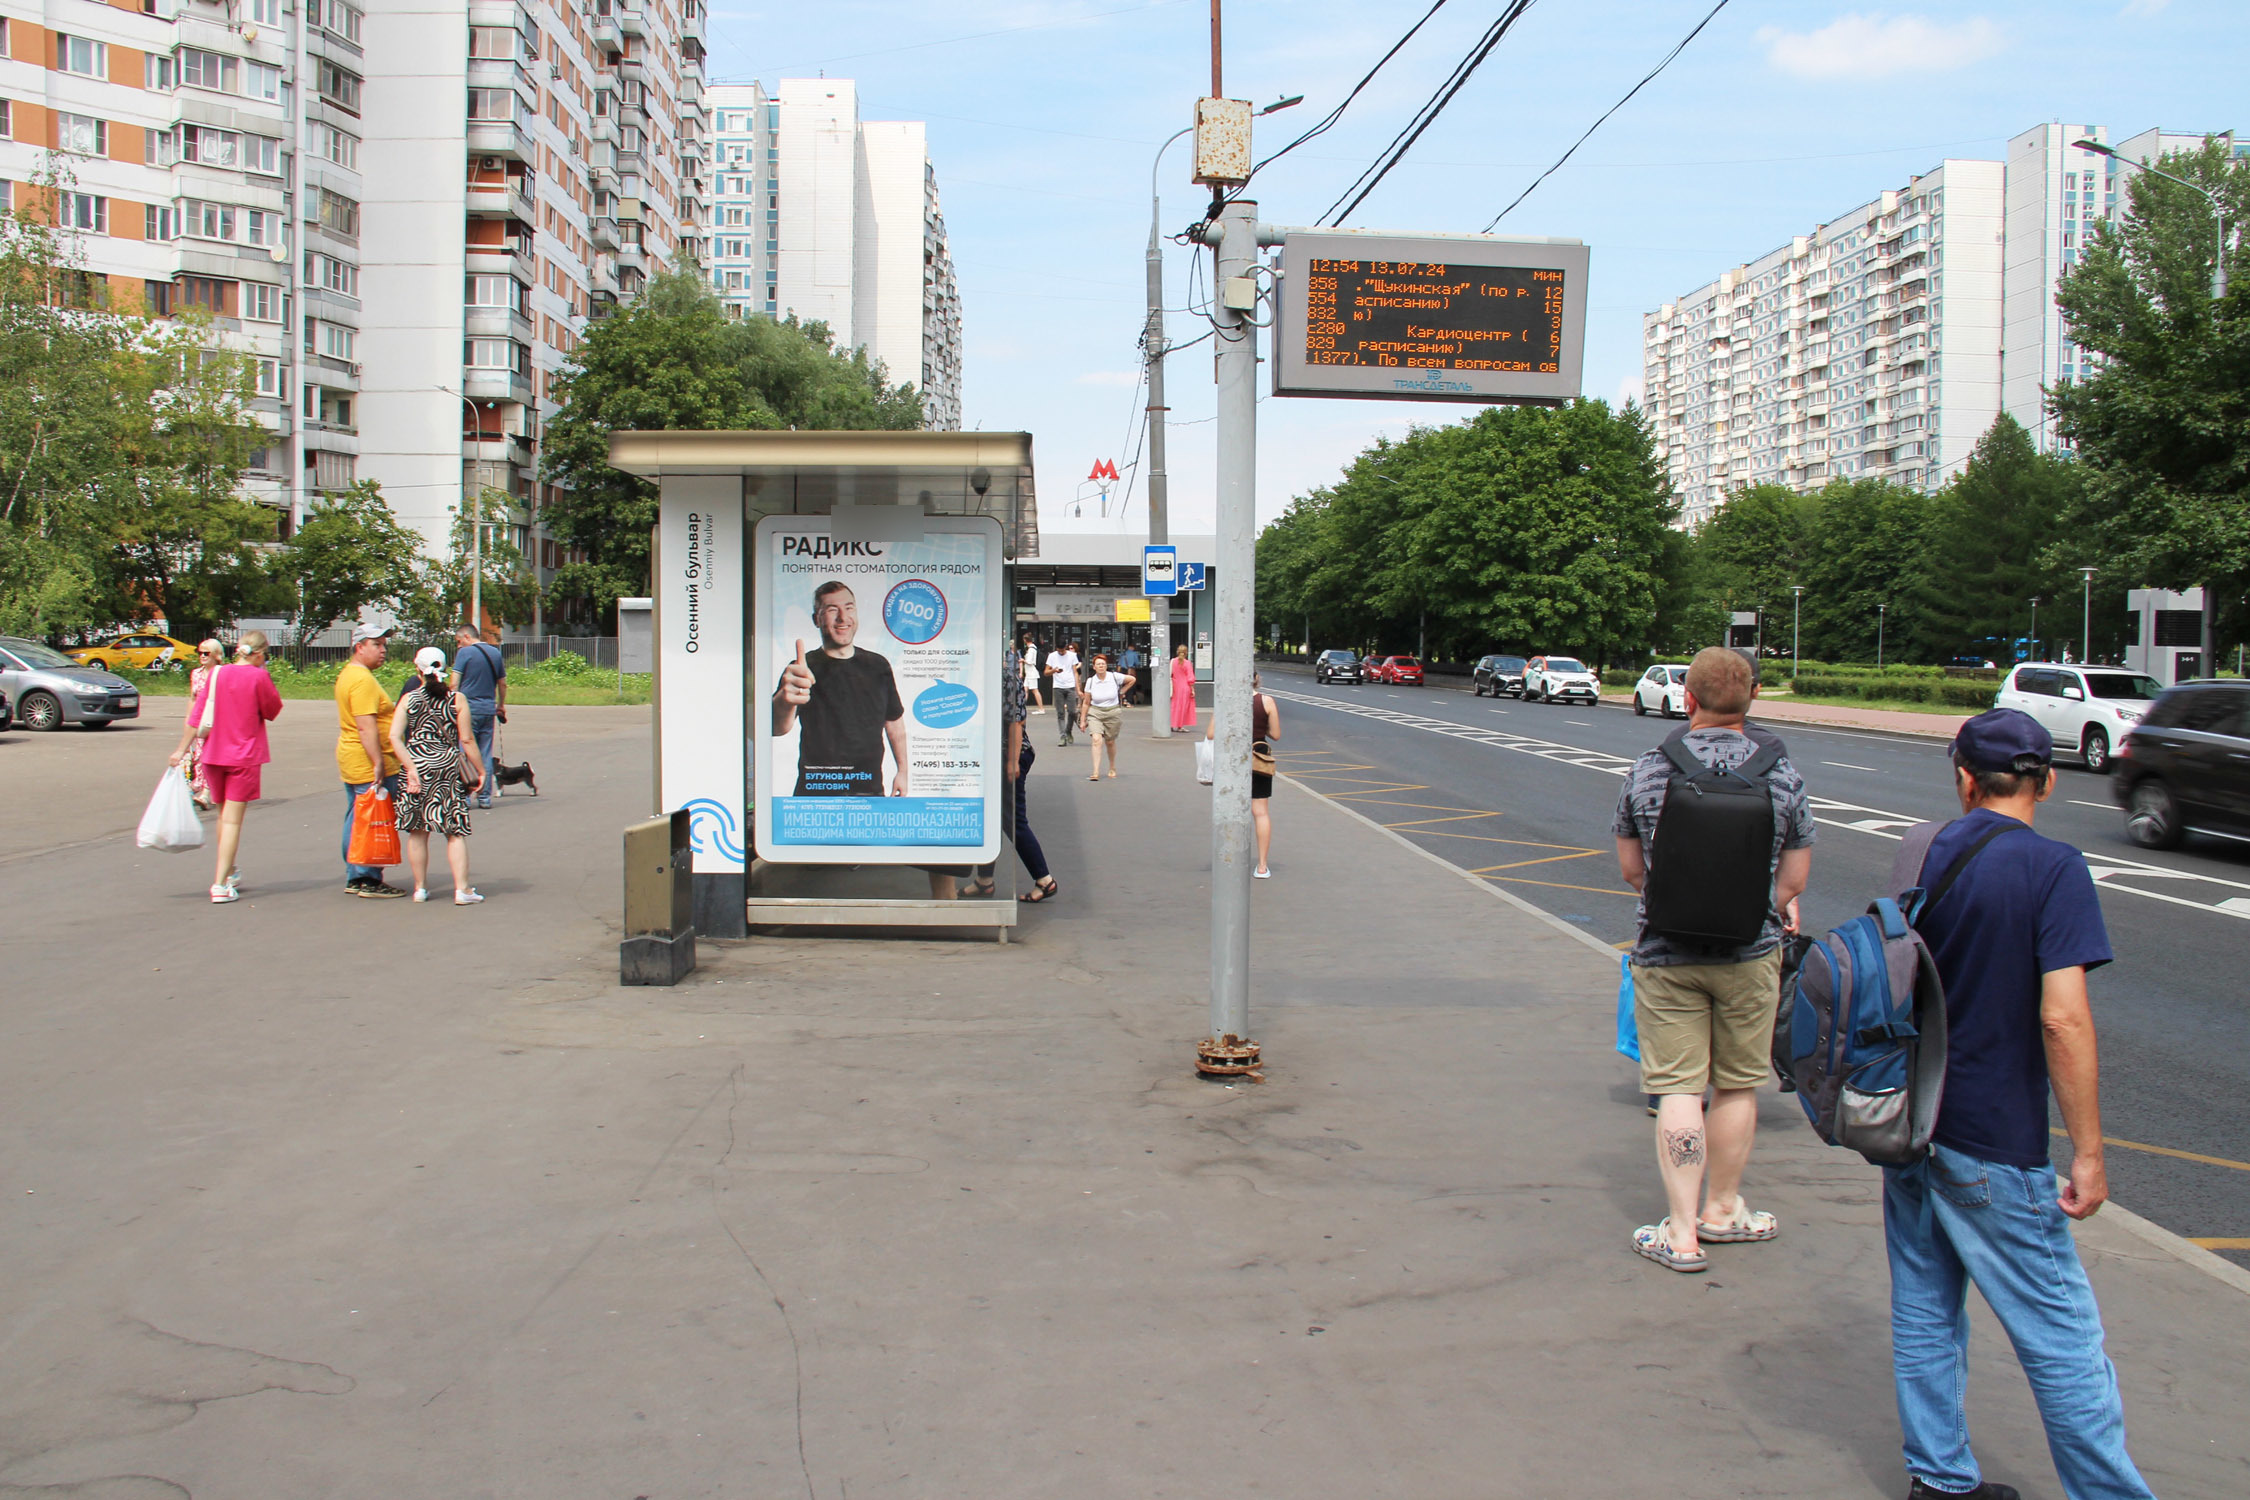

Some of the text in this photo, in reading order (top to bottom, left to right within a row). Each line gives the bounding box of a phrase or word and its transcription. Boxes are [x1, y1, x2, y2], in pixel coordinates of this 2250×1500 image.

[1312, 259, 1446, 276] 12:54 13.07.24
[1308, 276, 1338, 290] 358
[1545, 286, 1563, 300] 12
[1308, 292, 1563, 314] 554 асписанию) 15
[1307, 306, 1337, 320] 832
[1551, 316, 1560, 328] 3
[1407, 325, 1512, 342] Кардиоцентр
[1550, 330, 1560, 343] 6
[1306, 336, 1560, 358] 829 расписанию) 7
[1379, 354, 1398, 366] По
[1408, 357, 1446, 368] всем
[1454, 360, 1530, 372] вопросам
[1392, 380, 1473, 392] ТРАНСДЕТАЛЬ
[704, 513, 715, 590] Osenniy Bulvar
[782, 564, 981, 575] ПОНЯТНАЯ СТОМАТОЛОГИЯ РЯДОМ
[684, 513, 701, 654] Осенний бульвар
[898, 599, 934, 620] 1000
[1056, 604, 1114, 614] КРЫЛАТ
[912, 760, 940, 768] +7(495)
[805, 772, 872, 780] БУГУНОВ АРТЁМ
[784, 812, 982, 827] ИМЕЮТСЯ ПРОТИВОПОКАЗАНИЯ.
[784, 828, 844, 840] НЕОБХОДИМА
[846, 828, 914, 840] КОНСУЛЬТАЦИЯ
